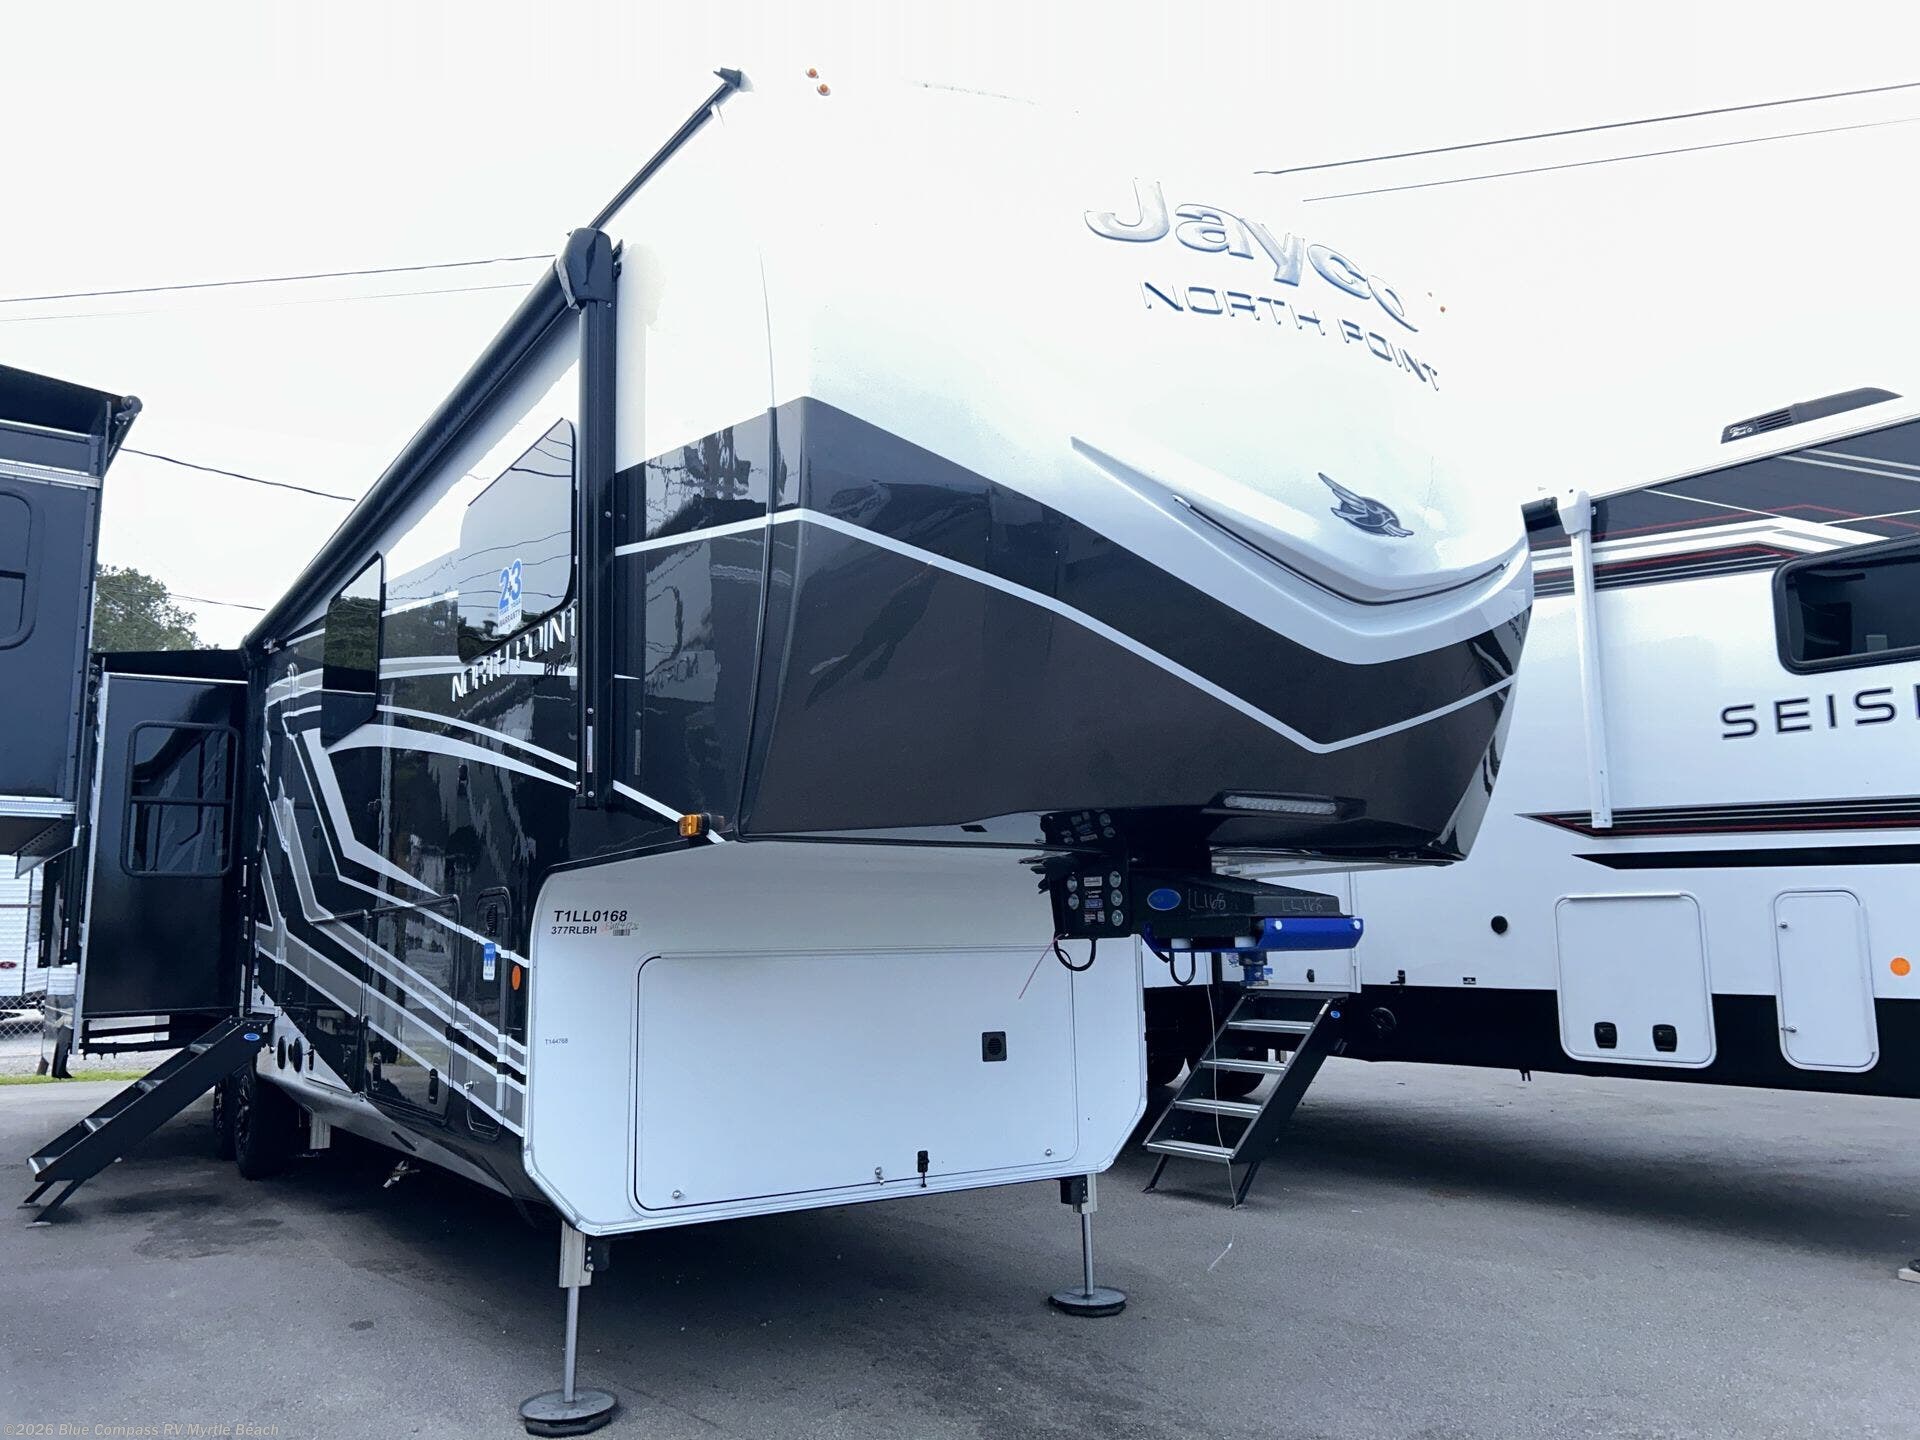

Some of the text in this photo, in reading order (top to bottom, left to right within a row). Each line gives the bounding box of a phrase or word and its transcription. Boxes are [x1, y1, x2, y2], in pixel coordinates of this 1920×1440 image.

[1084, 177, 1419, 332] Jayco
[1139, 281, 1440, 392] NORTH POINT
[1721, 683, 1920, 740] SEIS
[551, 926, 597, 935] 377RLBH
[553, 910, 628, 922] T1LL0168
